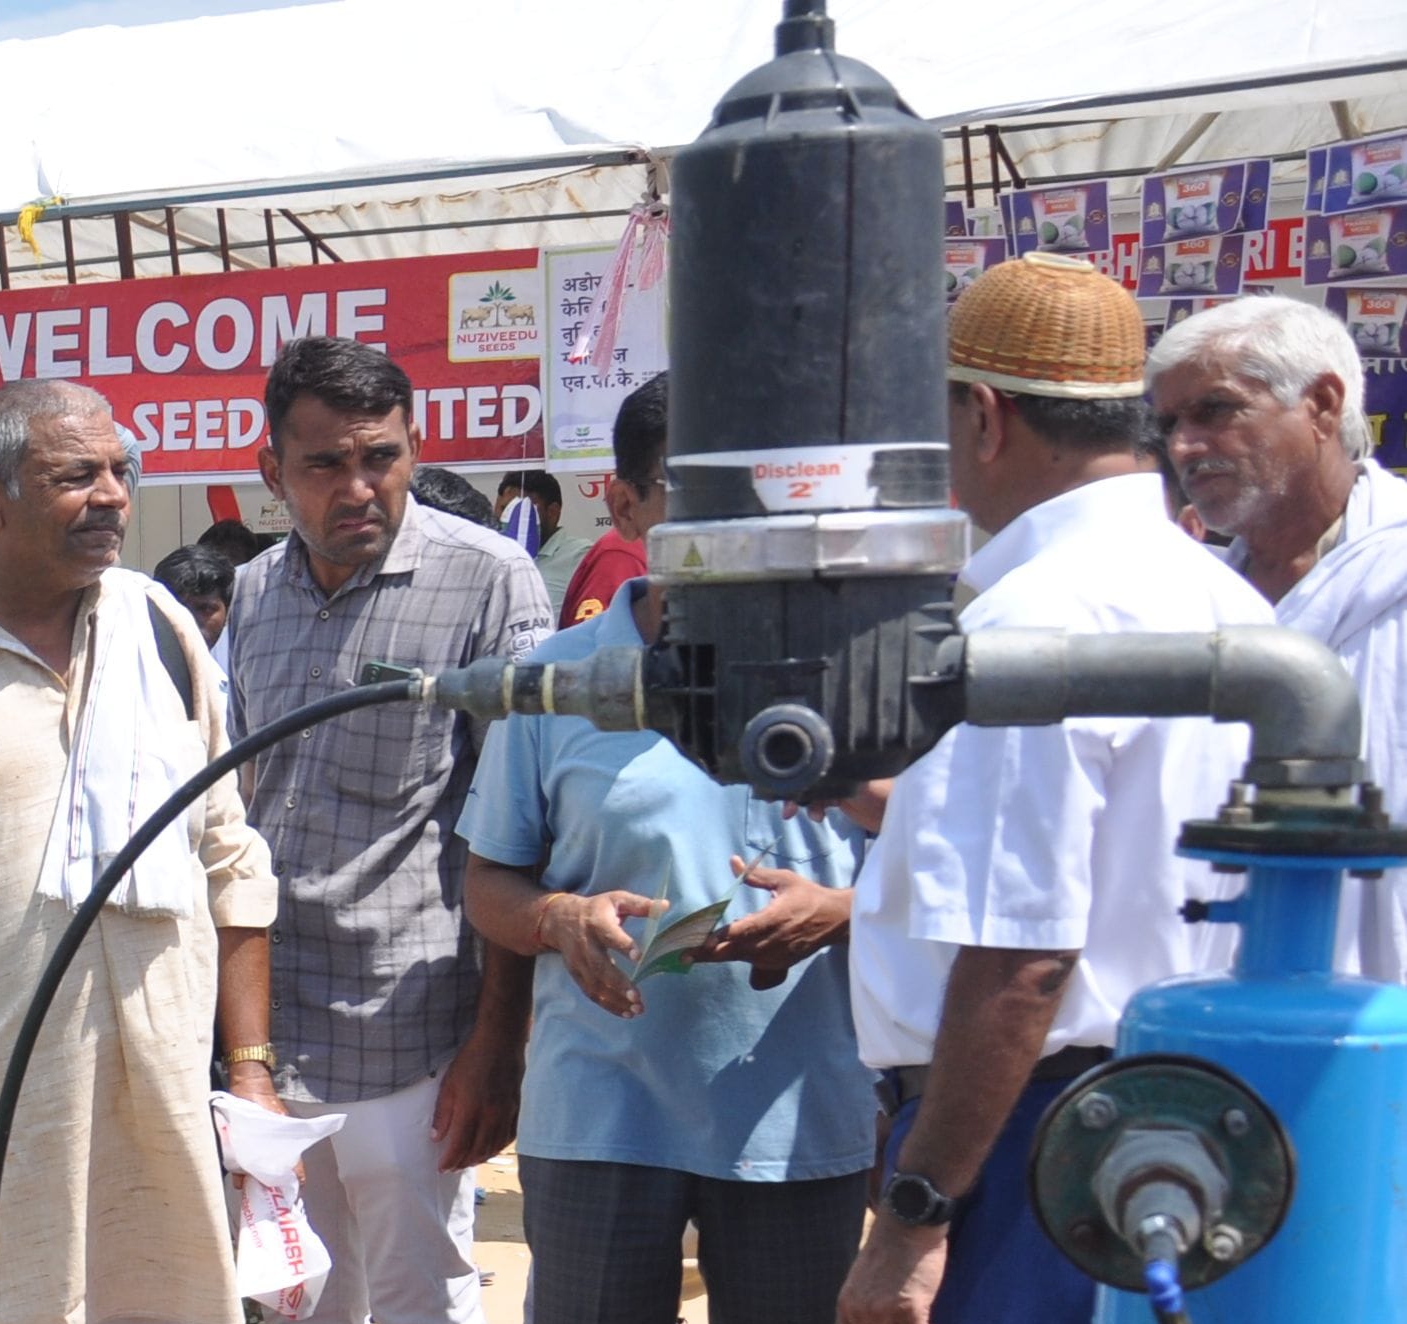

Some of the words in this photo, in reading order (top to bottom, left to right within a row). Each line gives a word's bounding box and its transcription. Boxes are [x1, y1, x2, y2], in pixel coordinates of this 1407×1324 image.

[1365, 299, 1391, 309] 360
[456, 330, 538, 344] NUZIVEEDU
[478, 342, 516, 352] SEEDS
[133, 398, 272, 452] SEED
[411, 384, 543, 440] ITED
[754, 461, 841, 479] Disclean
